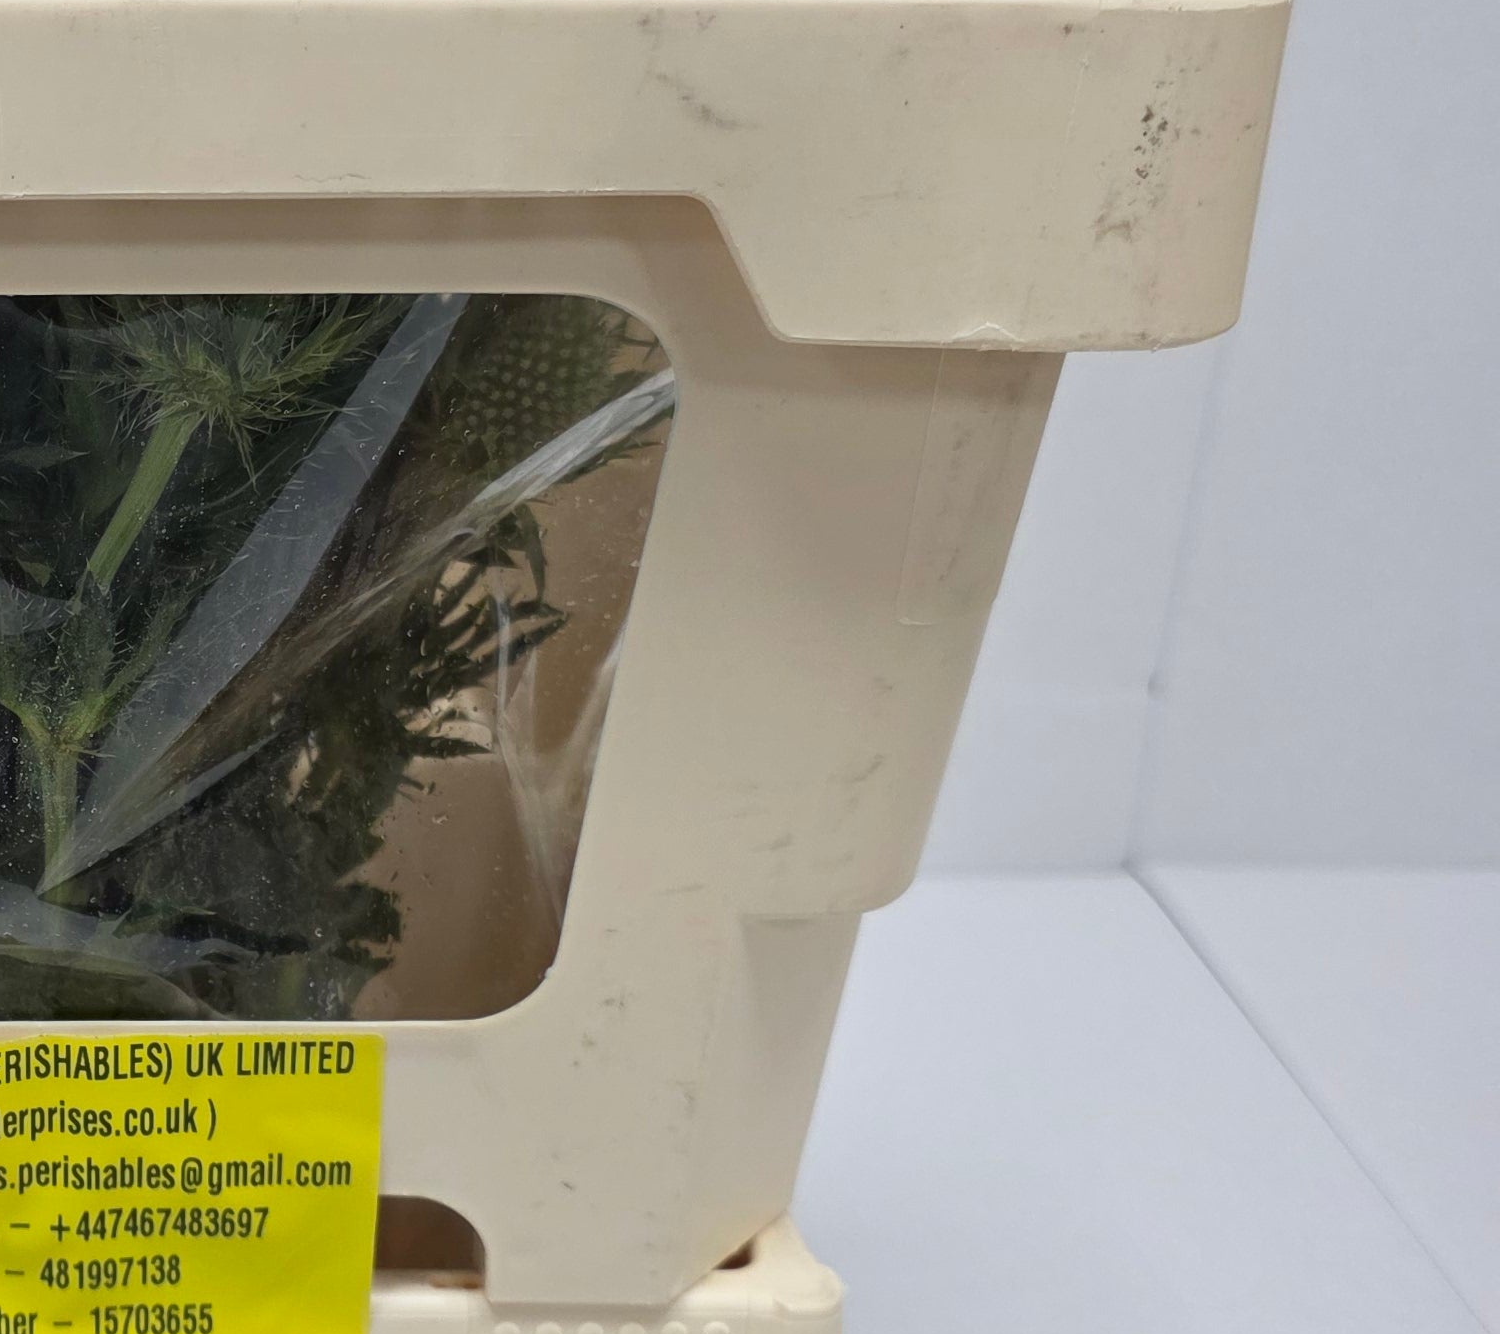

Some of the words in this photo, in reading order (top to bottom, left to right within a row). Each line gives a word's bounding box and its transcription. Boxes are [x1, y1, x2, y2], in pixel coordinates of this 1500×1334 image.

[185, 1041, 225, 1078] UK
[236, 1040, 355, 1077] LIMITED
[49, 1206, 269, 1243] +447467483697
[39, 1253, 181, 1291] 481997138
